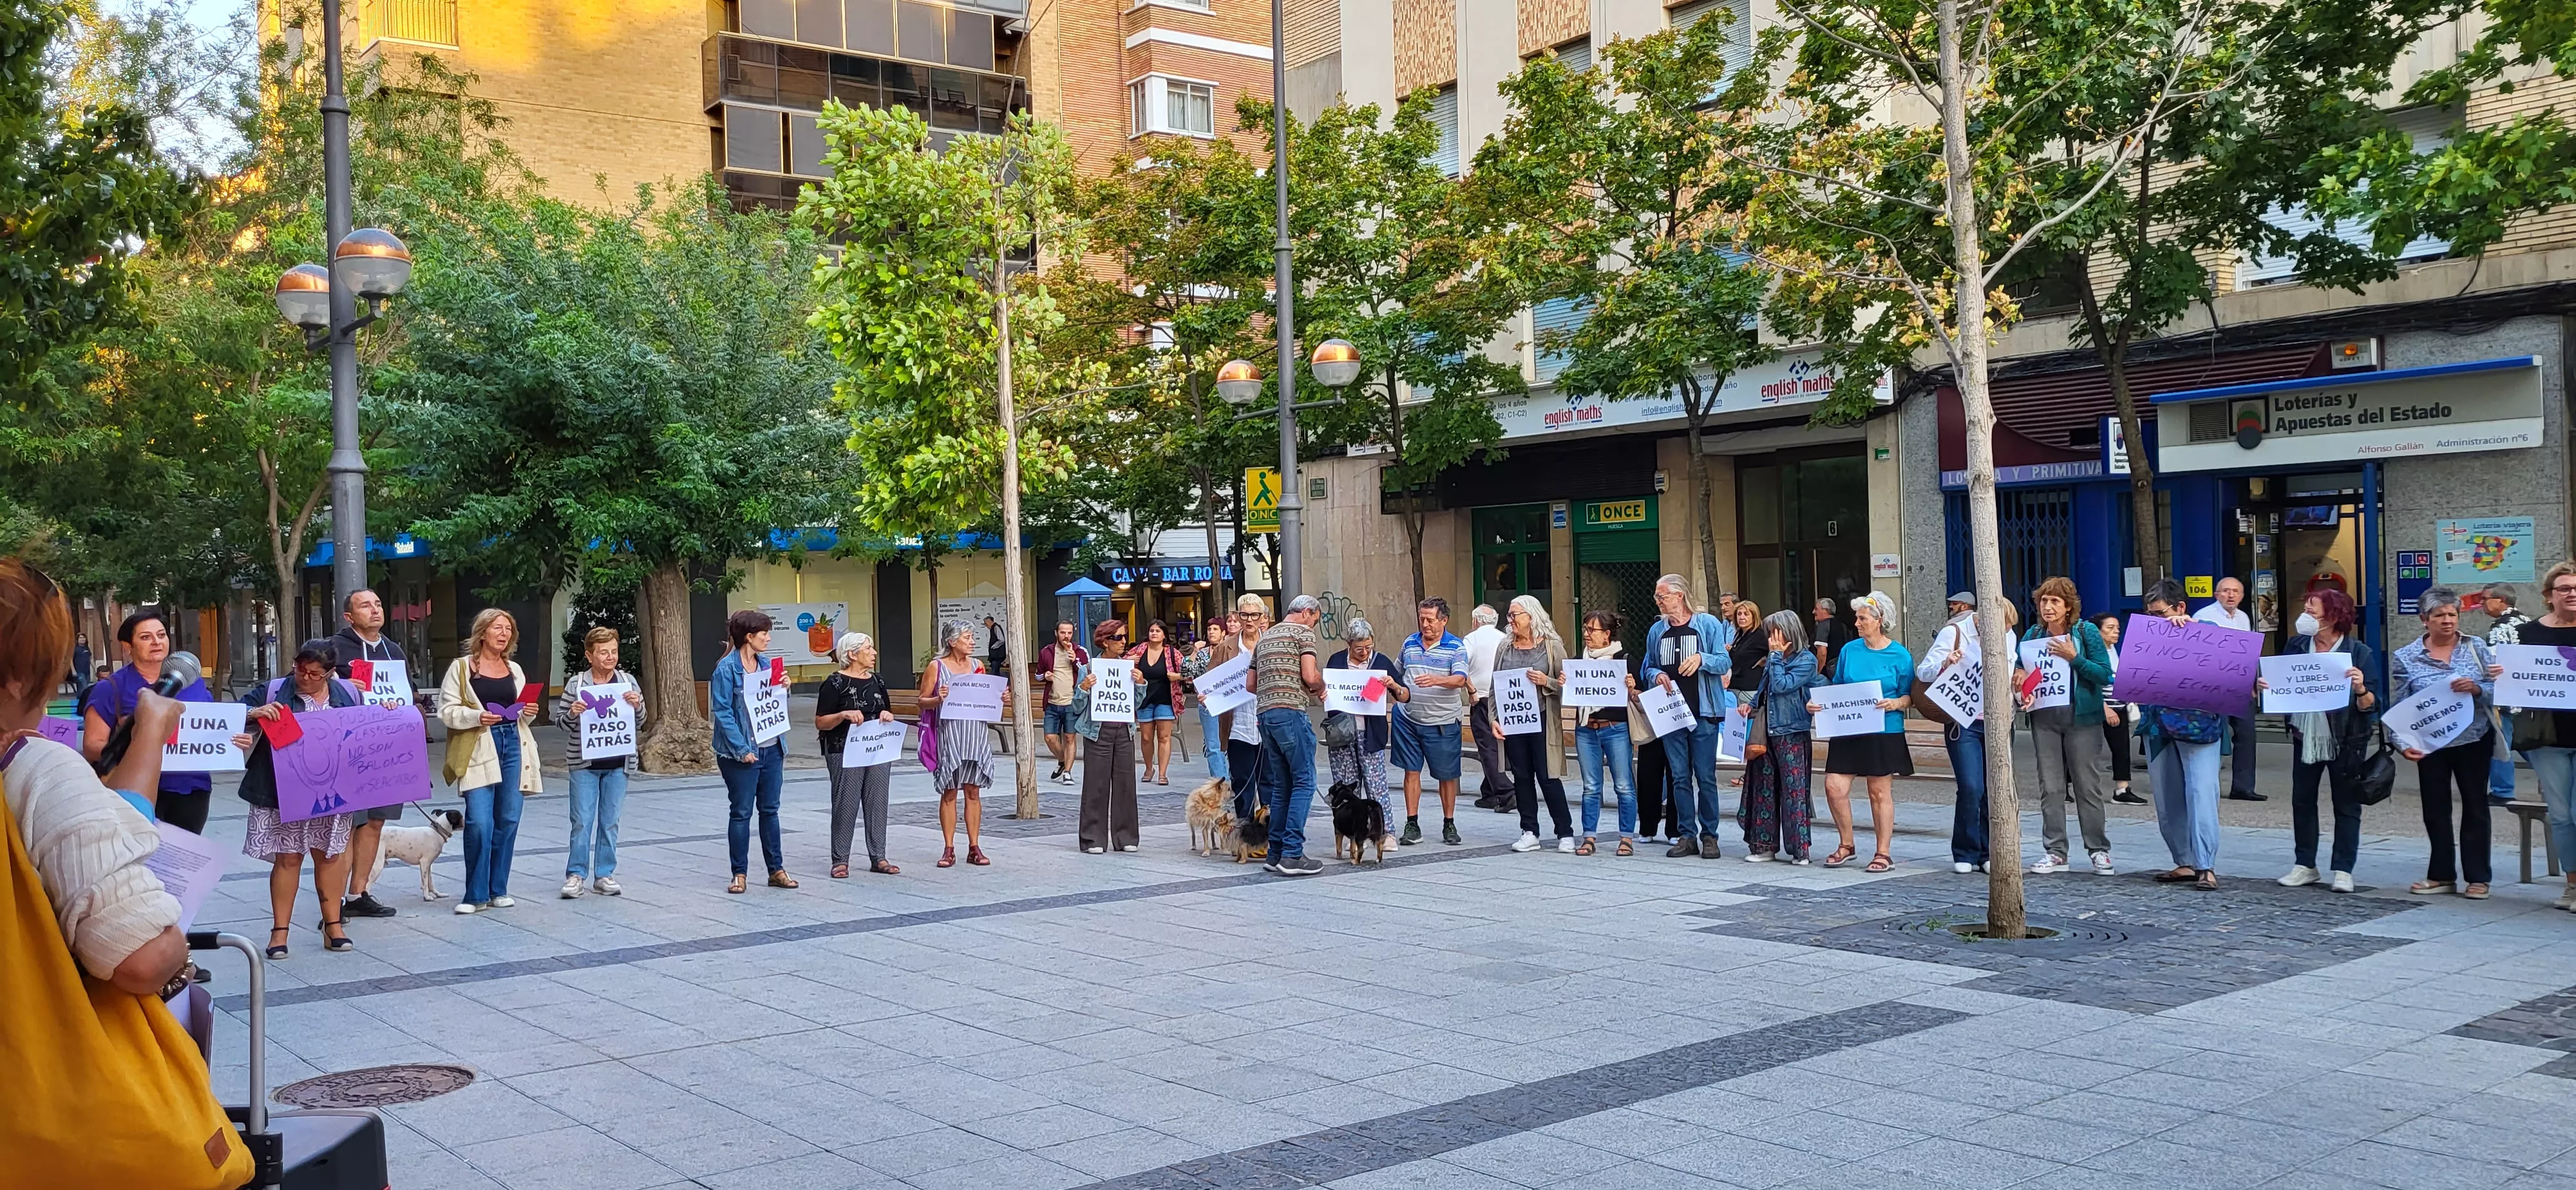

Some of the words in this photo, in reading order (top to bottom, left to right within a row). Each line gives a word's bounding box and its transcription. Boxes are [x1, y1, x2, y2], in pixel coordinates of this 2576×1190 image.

[1700, 384, 1713, 393] odo
[1724, 381, 1738, 390] año
[1761, 377, 1797, 403] english
[1803, 373, 1835, 392] maths
[2275, 392, 2342, 411] Loterías
[2348, 393, 2357, 408] y
[1508, 409, 1527, 419] C1-C2)
[1545, 407, 1573, 430] english
[1577, 404, 1602, 420] maths
[2275, 412, 2352, 435] Apuestas
[2358, 408, 2384, 424] del
[2391, 402, 2452, 422] Estado
[2395, 442, 2424, 451] Gallán
[2436, 435, 2508, 448] Administración
[2013, 468, 2020, 479] Y
[2032, 462, 2102, 478] PRIMITIVA
[1250, 510, 1277, 519] ONC
[1603, 504, 1641, 519] ONCE
[1830, 522, 1835, 534] 6
[1162, 567, 1189, 581] BAR
[1193, 566, 1233, 580] ROA
[2146, 620, 2249, 654] RUBIALES
[2035, 659, 2053, 670] UN
[2134, 642, 2151, 653] SI
[2157, 645, 2189, 660] NO
[2193, 652, 2213, 666] TE
[2219, 659, 2251, 676] VAS
[2535, 657, 2561, 666] NOS
[375, 671, 388, 682] NI
[1108, 668, 1119, 677] NI
[1212, 667, 1248, 690] MACHISM
[1575, 670, 1586, 678] NI
[1591, 670, 1616, 678] UNA
[1965, 668, 1982, 689] UN
[2040, 672, 2061, 683] SO
[2128, 667, 2162, 685] TE
[2296, 674, 2329, 683] LIBRES
[2512, 672, 2576, 682] QUEREMO
[1105, 679, 1121, 689] UN
[1510, 678, 1520, 688] NI
[1949, 673, 1980, 703] PASO
[373, 685, 395, 695] UN
[756, 689, 772, 701] UN
[1098, 690, 1127, 701] PASO
[1222, 683, 1245, 697] MATA
[1508, 690, 1524, 700] UN
[1575, 687, 1616, 695] MENOS
[1666, 688, 1681, 698] NOS
[2295, 684, 2346, 695] QUEREMOS
[2527, 688, 2566, 698] VIVAS
[1832, 698, 1878, 709] MACHISMO
[1936, 683, 1976, 717] ATRÁS
[2416, 697, 2438, 711] NOS
[754, 699, 779, 717] PASO
[1095, 702, 1131, 713] ATRÁS
[1504, 702, 1532, 713] PASO
[757, 711, 785, 732] ATRÁS
[1504, 712, 1538, 725] ATRÁS
[1672, 711, 1692, 722] VIVAS
[1838, 713, 1862, 721] MATA
[2410, 701, 2463, 730] QUEREMOS
[191, 718, 228, 730] UNA
[589, 721, 627, 733] PASO
[2429, 721, 2458, 739] VIVAS
[53, 724, 70, 737] #
[862, 731, 900, 742] MACHISMO
[586, 732, 631, 748] ATRÁS
[166, 742, 226, 755] MENOS
[348, 745, 364, 760] NO
[368, 741, 393, 755] SON
[866, 744, 884, 753] MATA
[353, 750, 414, 774] BALONES
